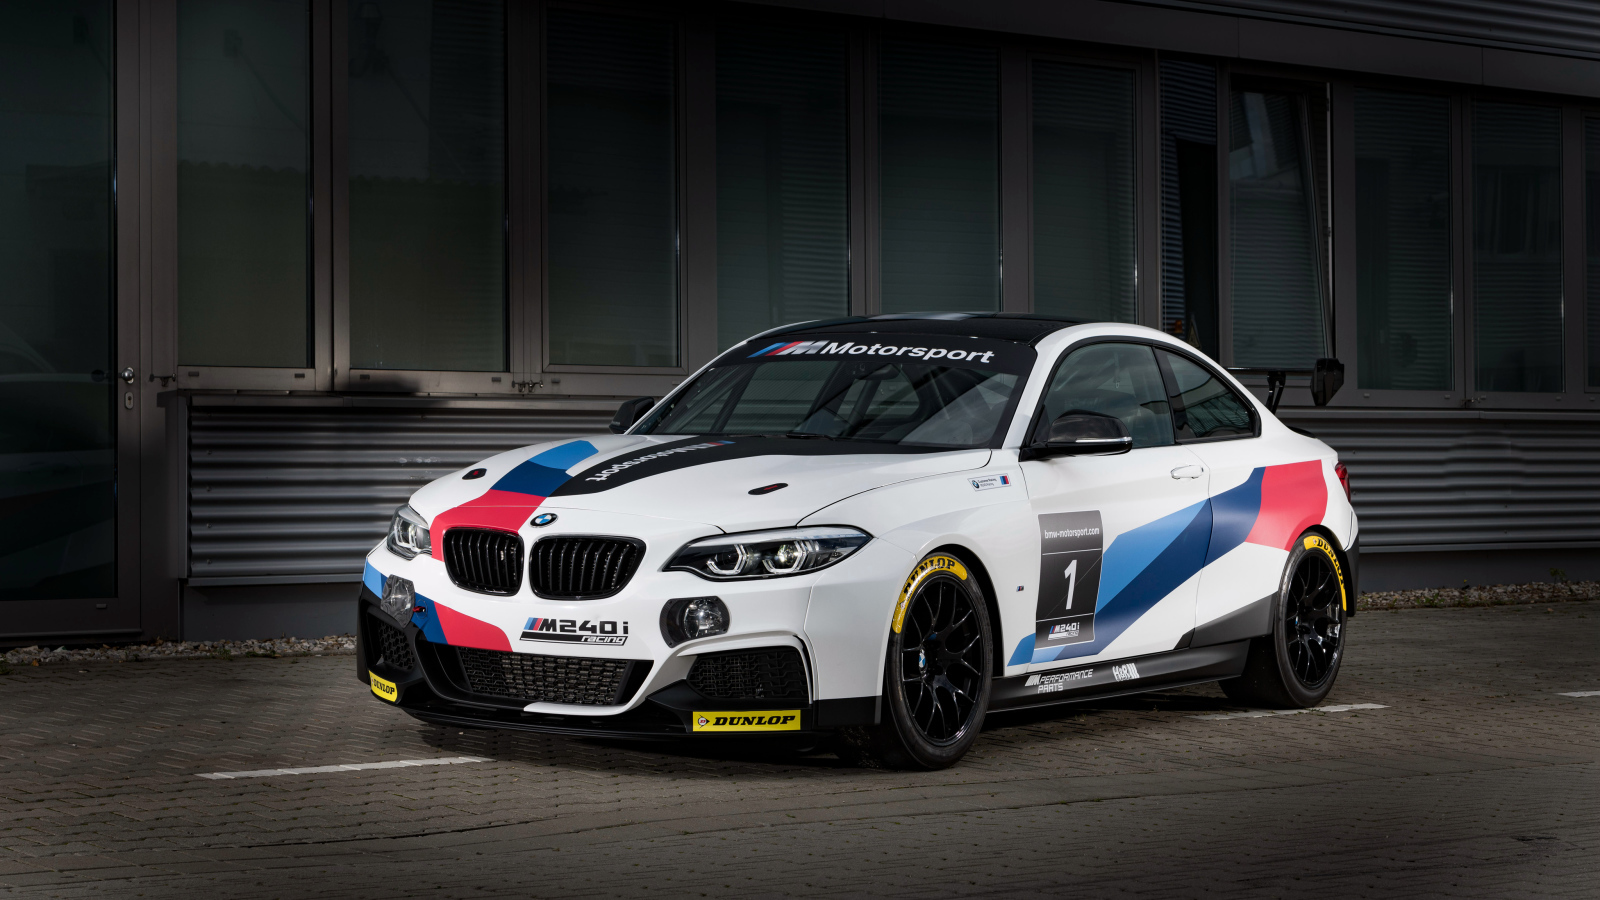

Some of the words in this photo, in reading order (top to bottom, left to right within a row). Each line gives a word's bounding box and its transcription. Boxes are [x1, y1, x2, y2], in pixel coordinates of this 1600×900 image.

[820, 342, 995, 363] Motorsport
[585, 446, 688, 481] Motorsport
[1044, 528, 1100, 539] bmw-motorsport.com
[1064, 559, 1077, 610] 1
[581, 635, 626, 645] racing
[1040, 669, 1094, 684] PERFORMANCE
[373, 678, 395, 695] DUNLOP
[1038, 683, 1064, 694] PARTS
[713, 715, 796, 726] DUNLOP
